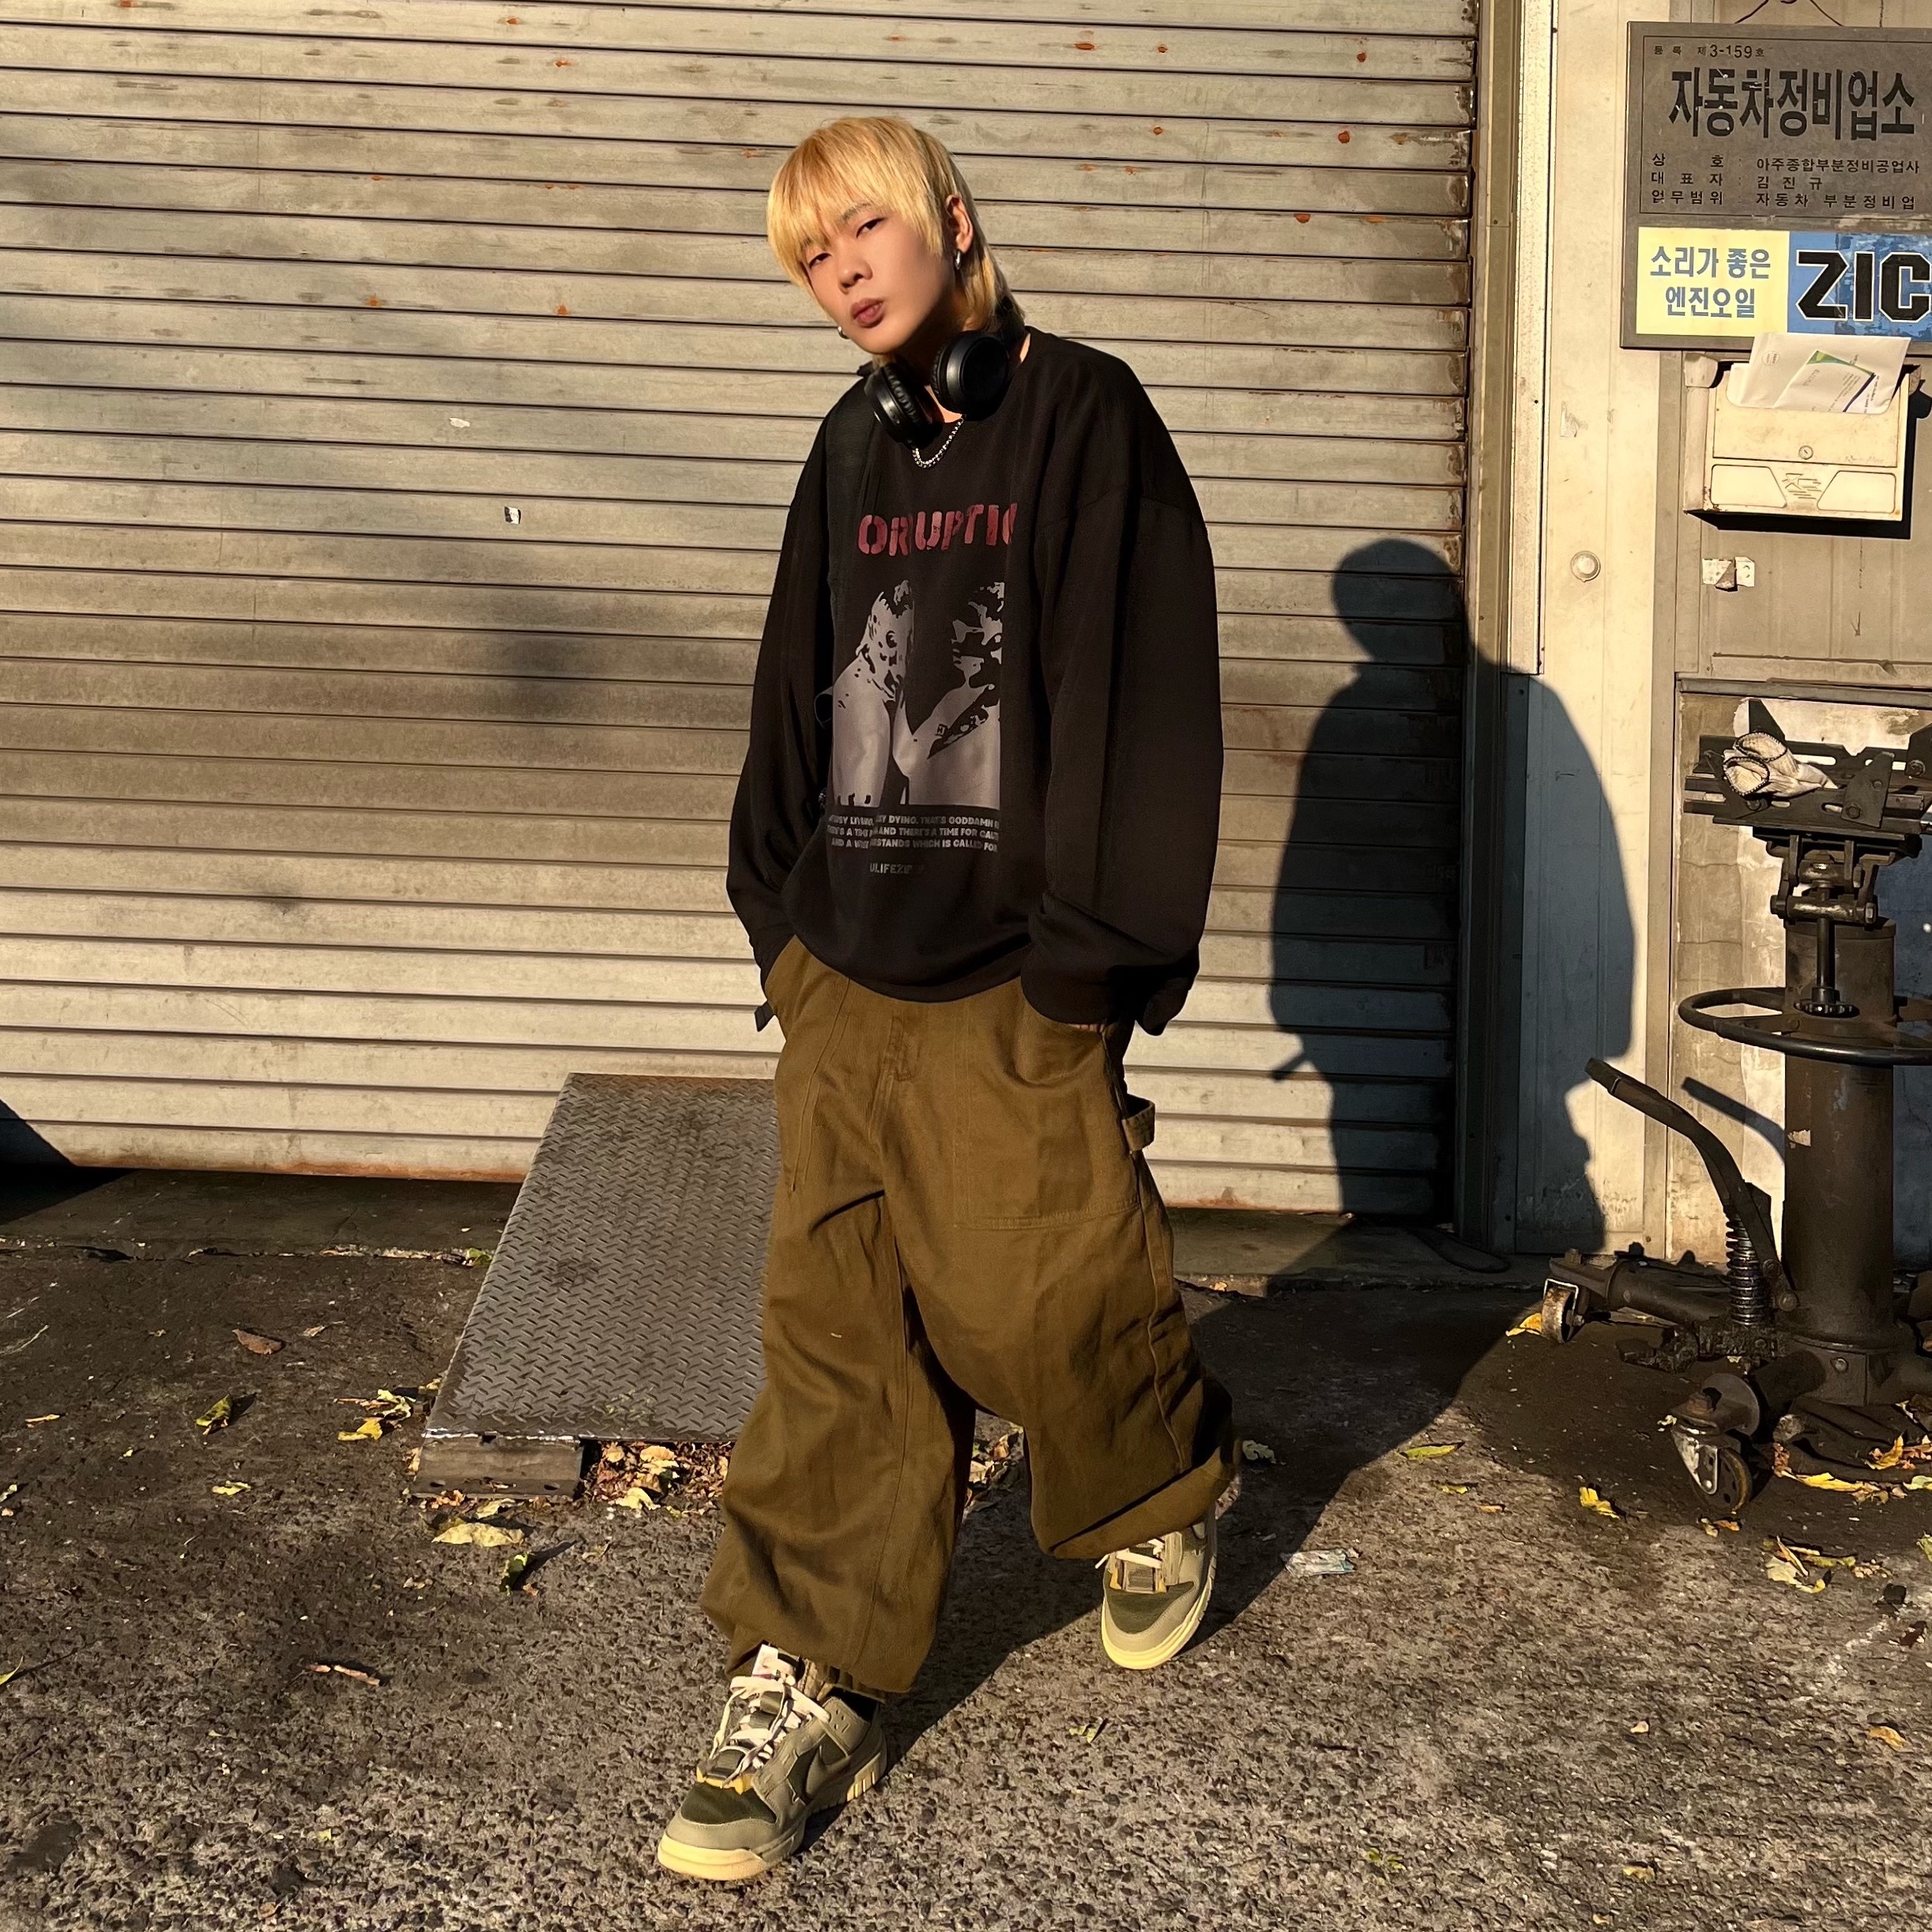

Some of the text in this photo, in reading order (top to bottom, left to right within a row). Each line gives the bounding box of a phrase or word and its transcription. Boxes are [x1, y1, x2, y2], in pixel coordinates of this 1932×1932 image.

[1668, 66, 1915, 141] 자동차정비업소
[1756, 157, 1920, 174] 아주종합부분정비공업사
[1650, 247, 1771, 279] 소리가 좋은
[1665, 286, 1755, 318] 엔진오일
[1795, 250, 1932, 323] ZIC
[942, 839, 951, 848] IS
[961, 828, 977, 837] FOR
